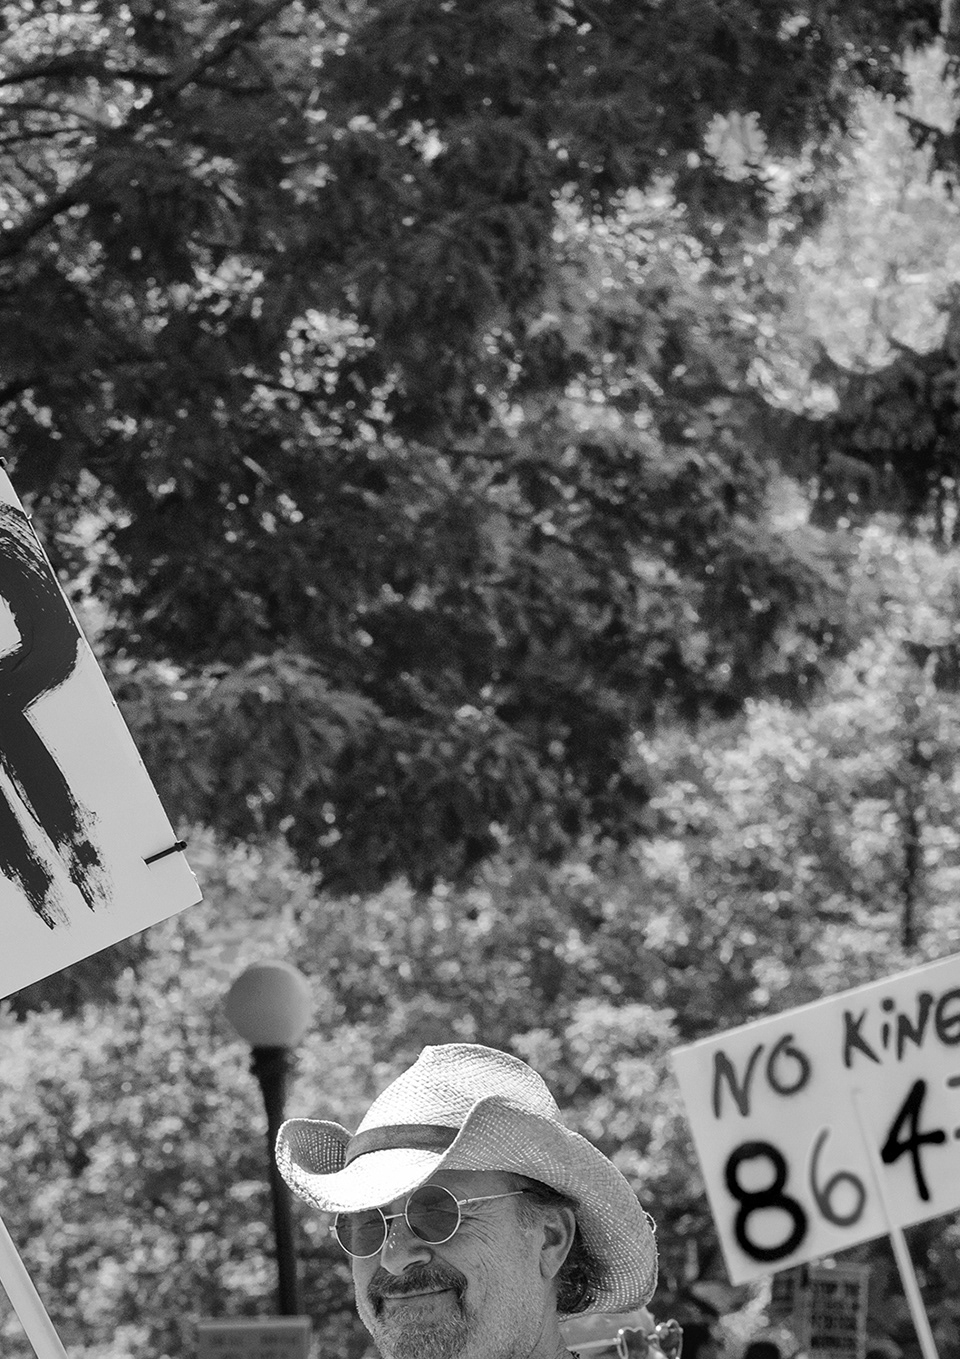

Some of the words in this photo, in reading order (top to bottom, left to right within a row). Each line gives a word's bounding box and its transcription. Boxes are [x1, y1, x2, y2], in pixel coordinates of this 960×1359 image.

[711, 1033, 812, 1121] NO
[723, 1126, 867, 1263] 86
[881, 1077, 960, 1203] 4
